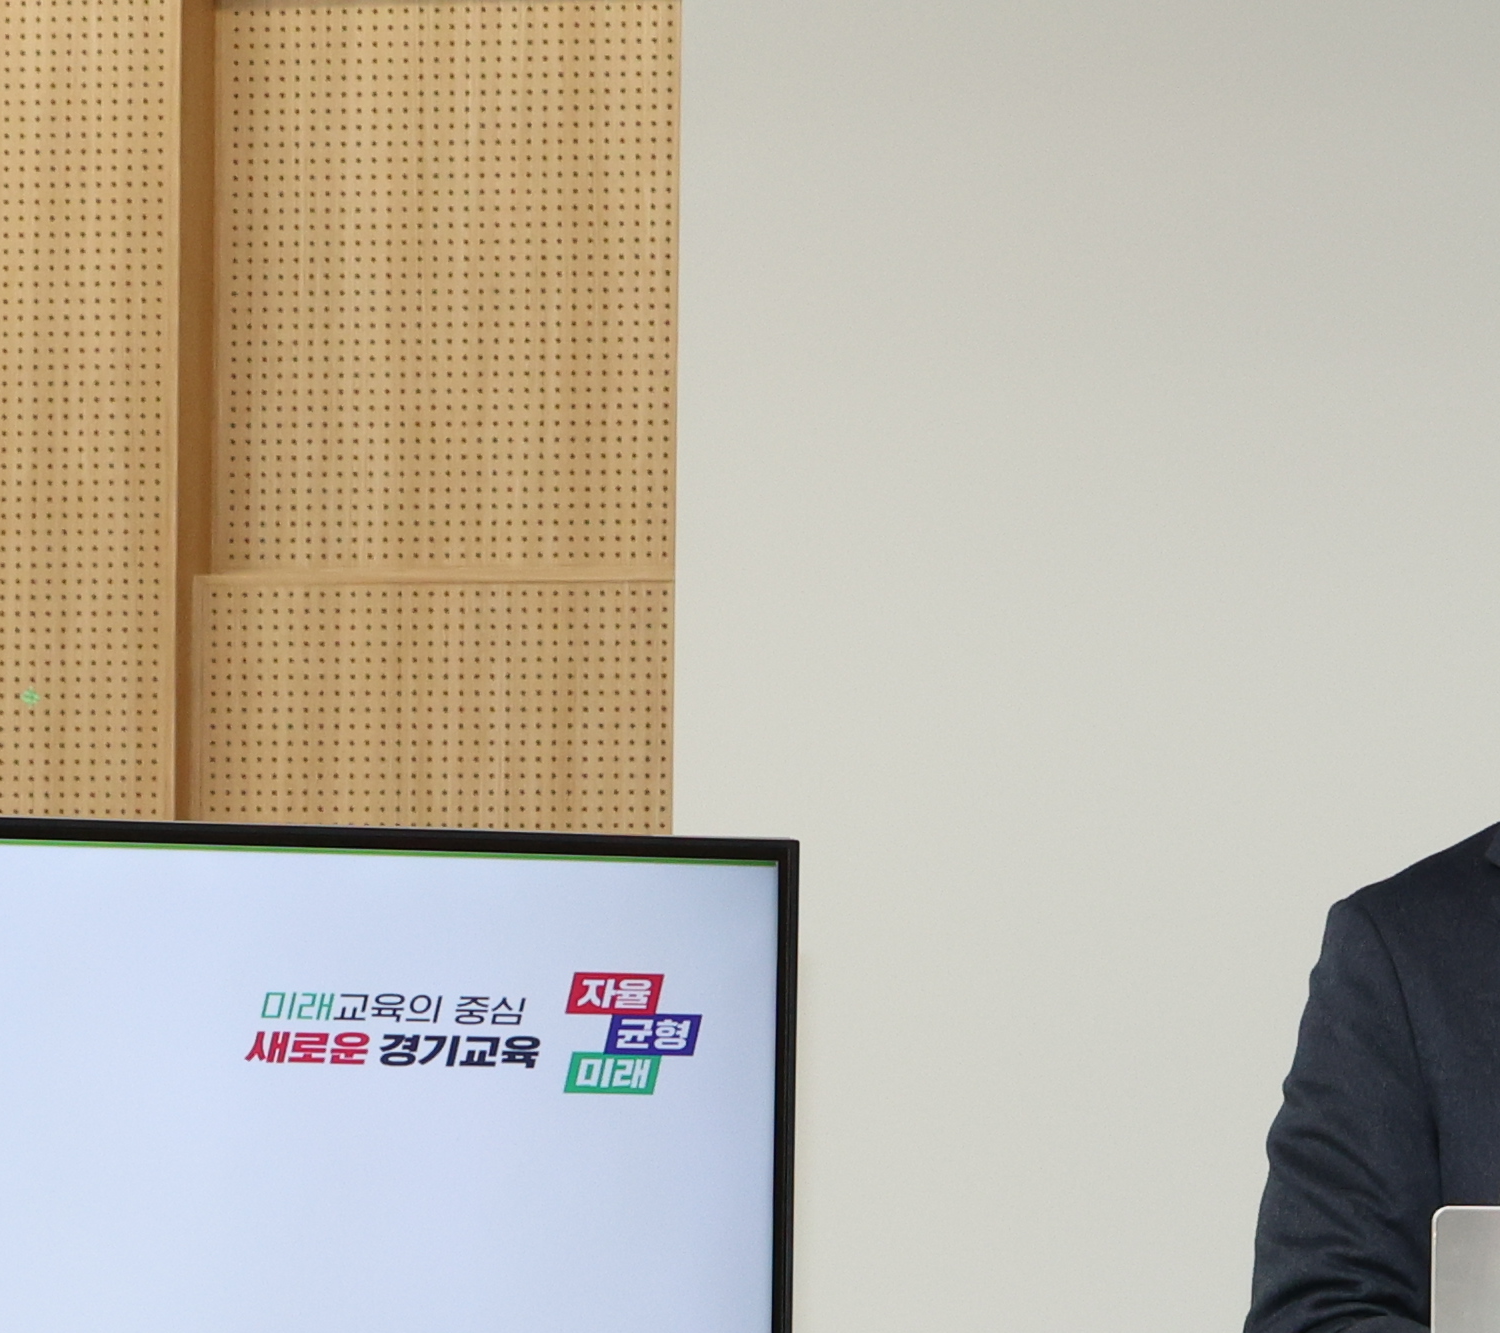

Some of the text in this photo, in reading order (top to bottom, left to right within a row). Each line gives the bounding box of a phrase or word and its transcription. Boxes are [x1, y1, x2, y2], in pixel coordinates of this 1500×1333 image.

[260, 991, 527, 1026] 미래교육의 중심
[576, 978, 653, 1010] 자율
[244, 1030, 541, 1069] 새로운 경기교육
[615, 1018, 691, 1051] 균형
[575, 1057, 652, 1090] 미래
